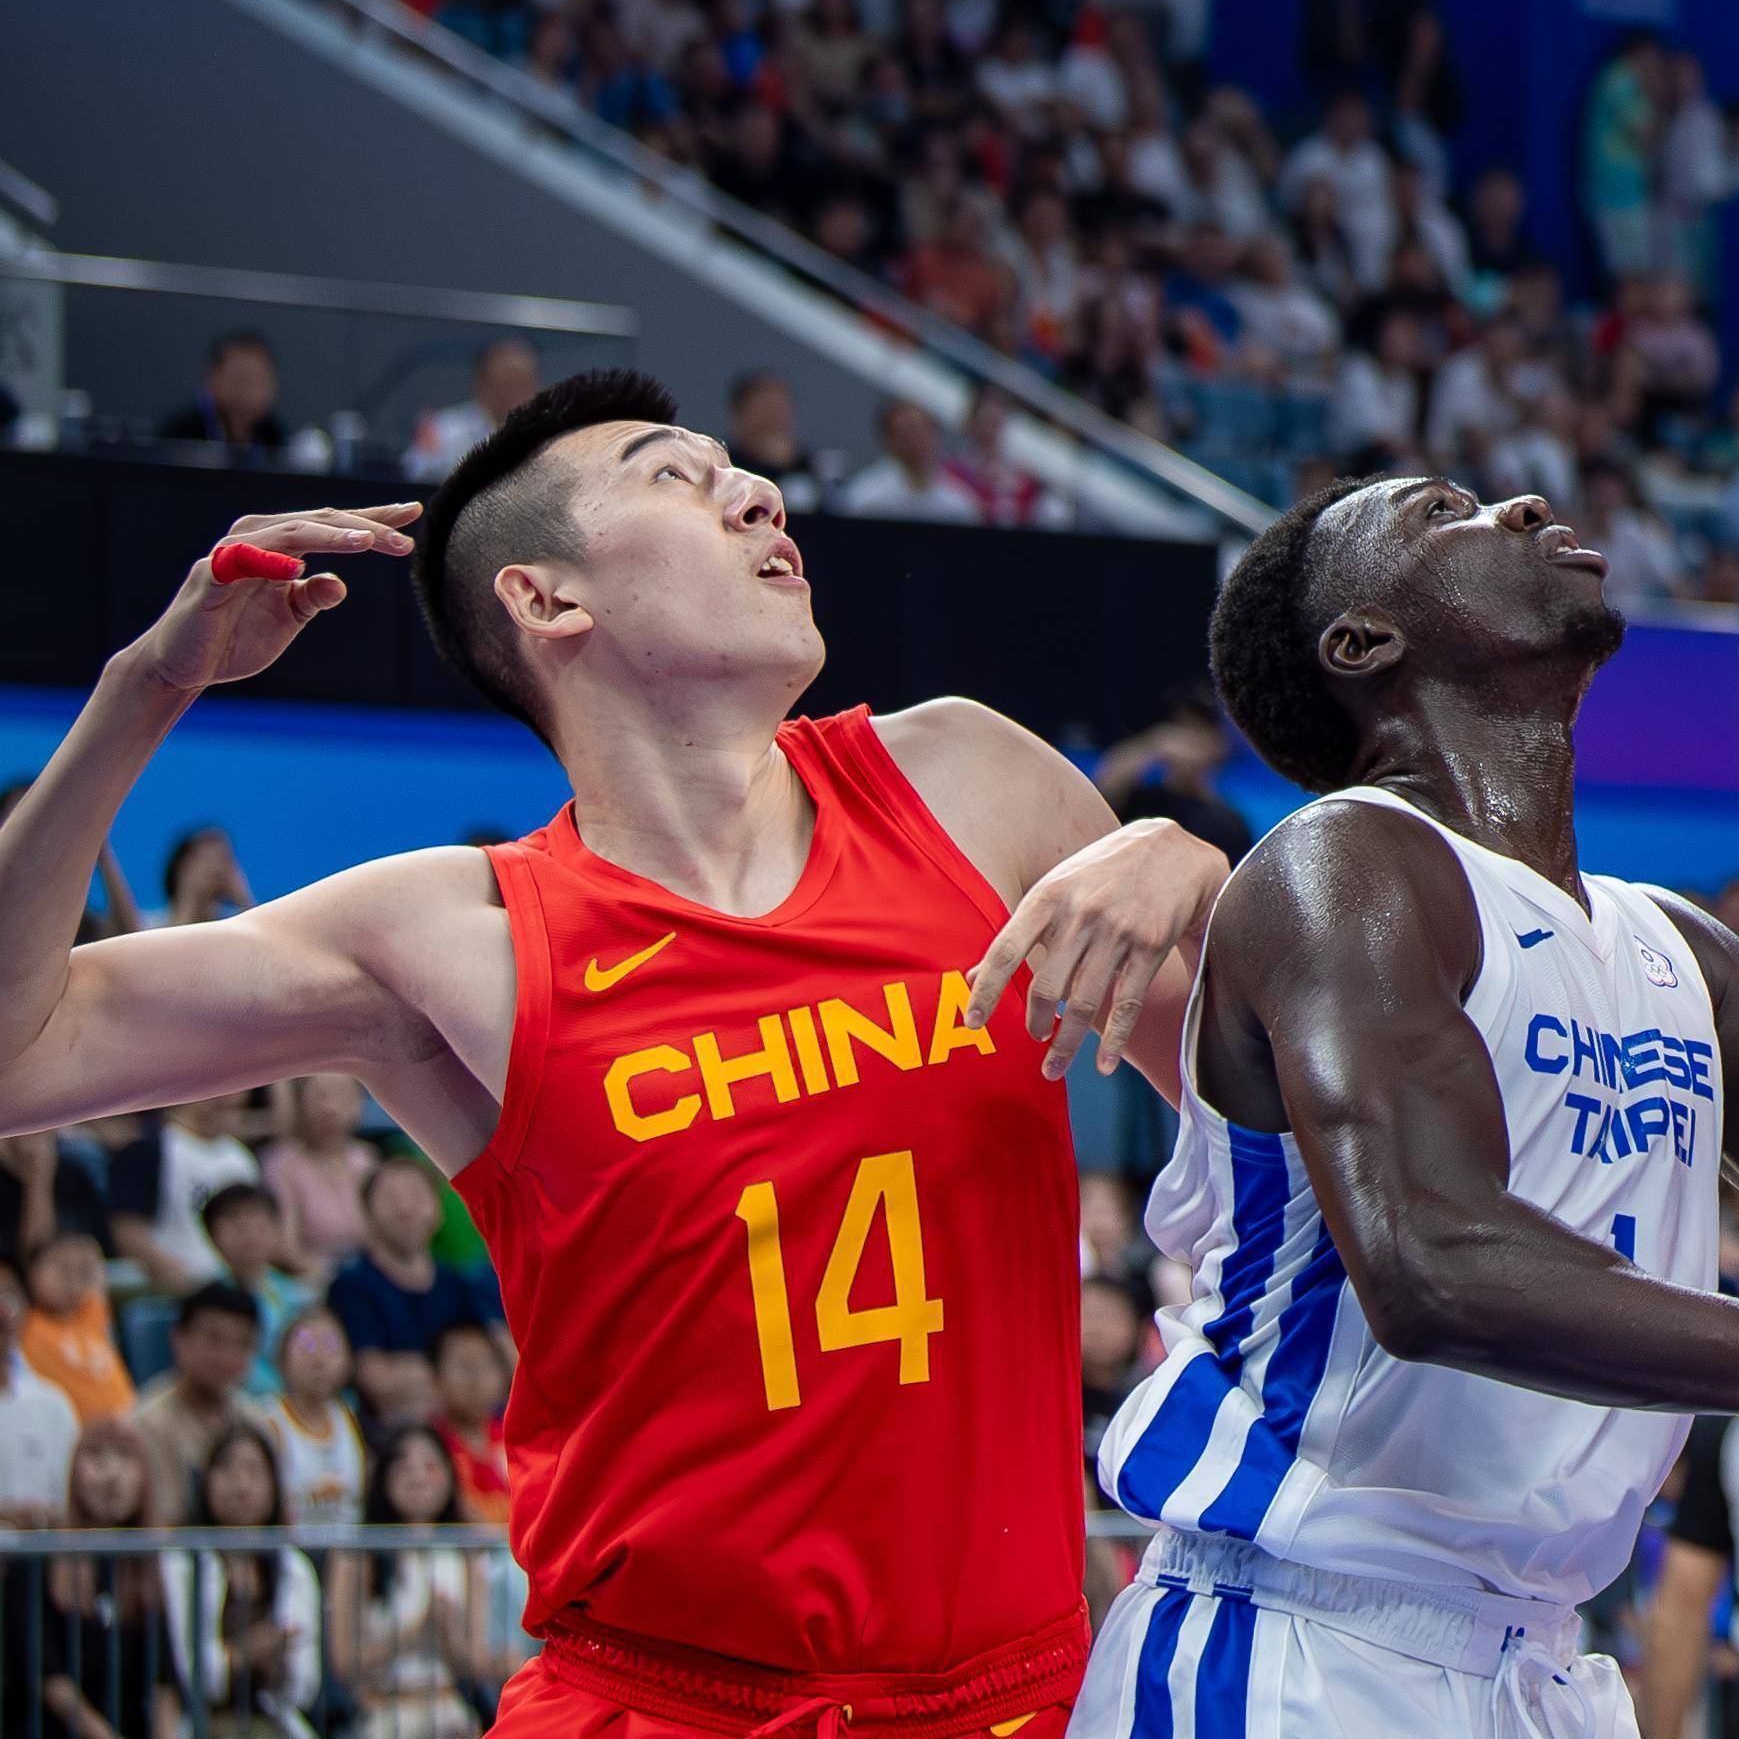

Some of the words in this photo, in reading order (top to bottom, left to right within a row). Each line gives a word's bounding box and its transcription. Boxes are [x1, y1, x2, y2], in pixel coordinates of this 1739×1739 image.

[603, 970, 996, 1141] CHINA
[1524, 1013, 1714, 1102] CHINESE
[1564, 1092, 1696, 1168] TAIPEI
[735, 1150, 943, 1410] 14
